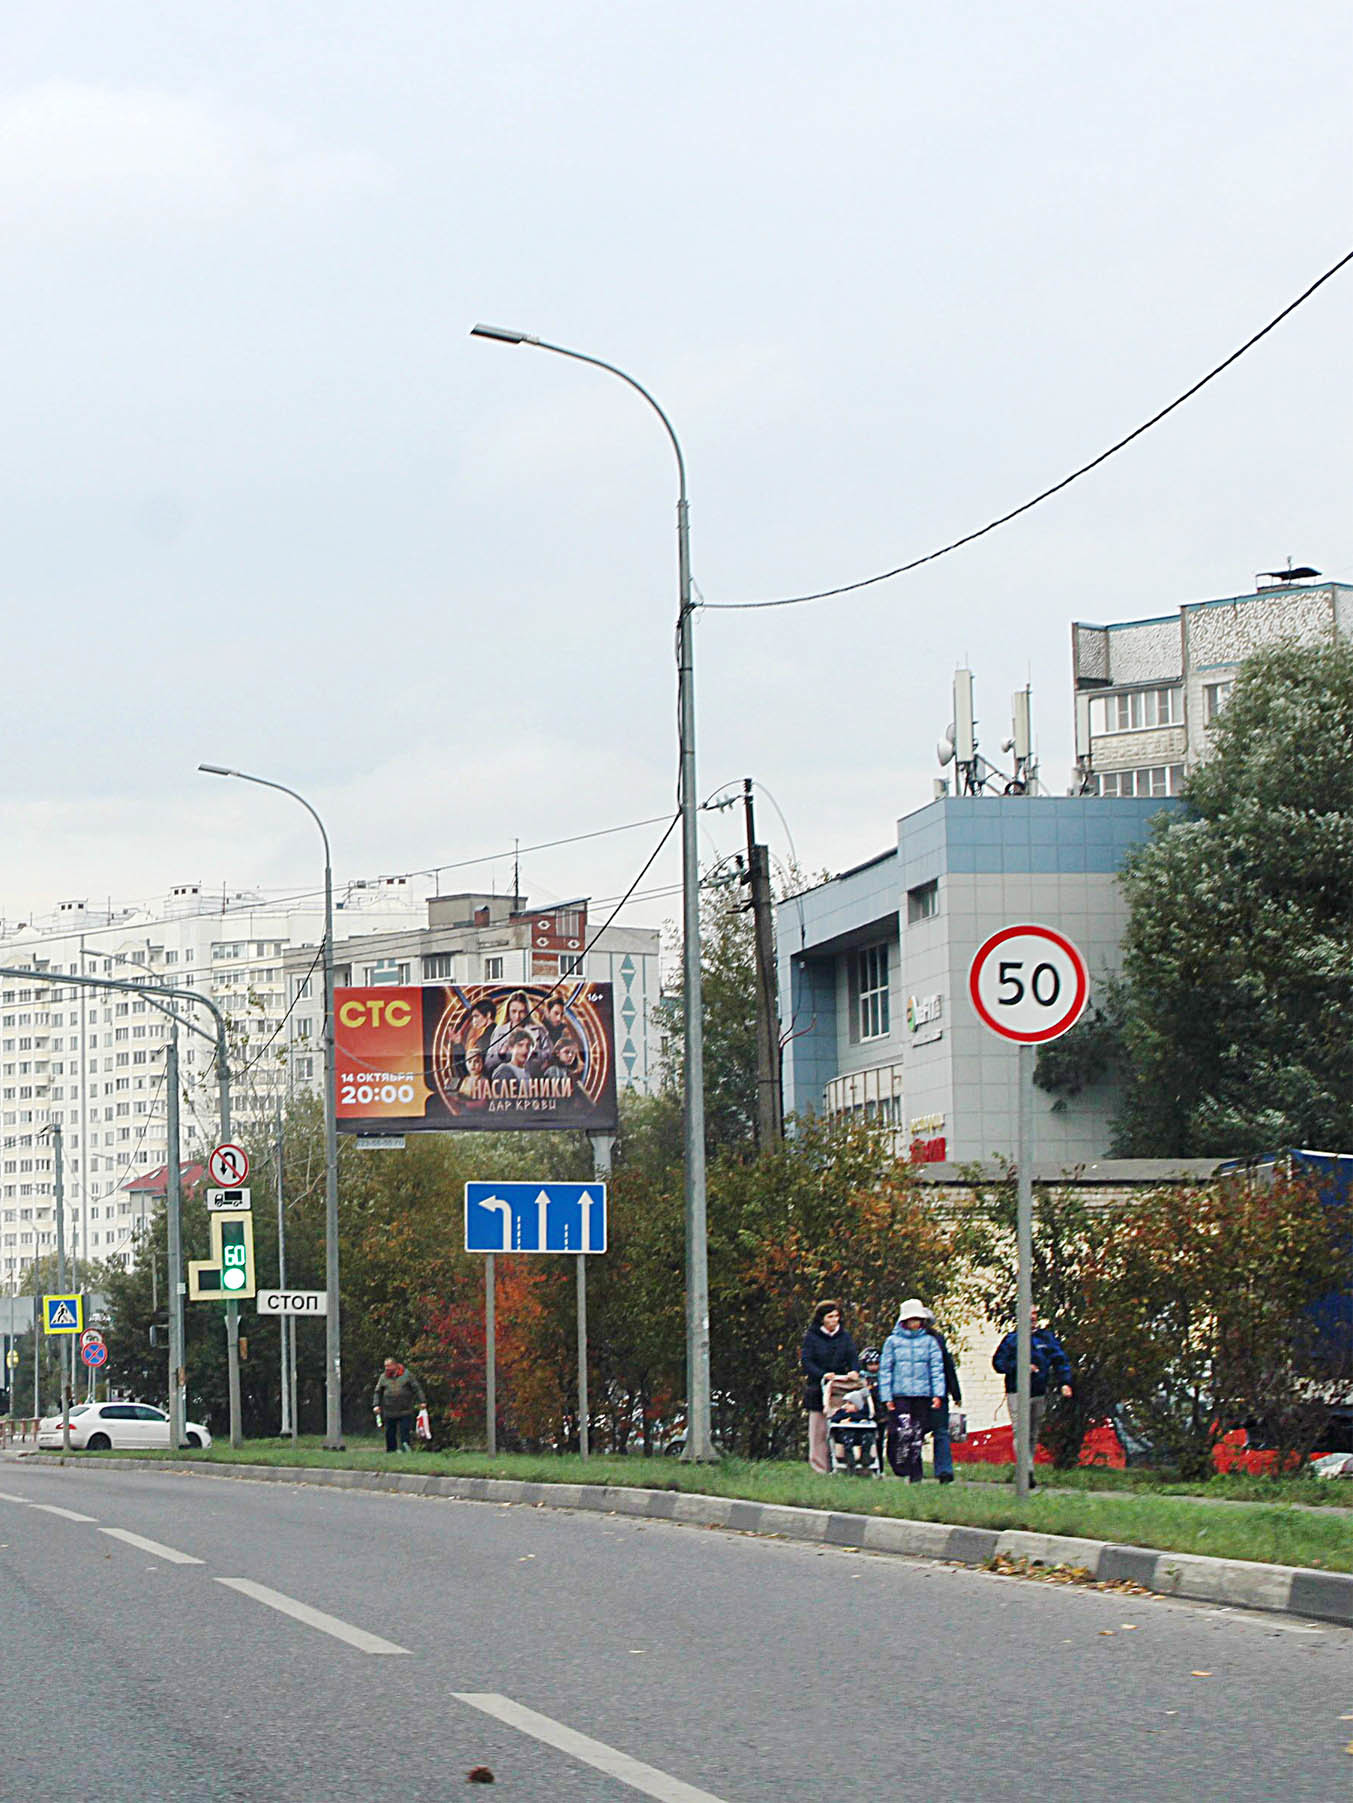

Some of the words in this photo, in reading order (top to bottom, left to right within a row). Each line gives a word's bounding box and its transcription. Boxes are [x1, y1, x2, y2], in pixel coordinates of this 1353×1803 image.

[998, 962, 1060, 1007] 50
[587, 993, 603, 1002] 16+
[339, 1000, 412, 1028] СТС
[341, 1073, 354, 1083] 14
[356, 1071, 414, 1082] ОКТЯБРЯ
[341, 1084, 414, 1104] 20:00
[471, 1078, 573, 1100] НАСЛЕДНИКИ
[488, 1099, 511, 1112] ДАР
[515, 1099, 557, 1112] КРОВИ
[224, 1245, 245, 1266] 60
[267, 1294, 318, 1310] СТОП
